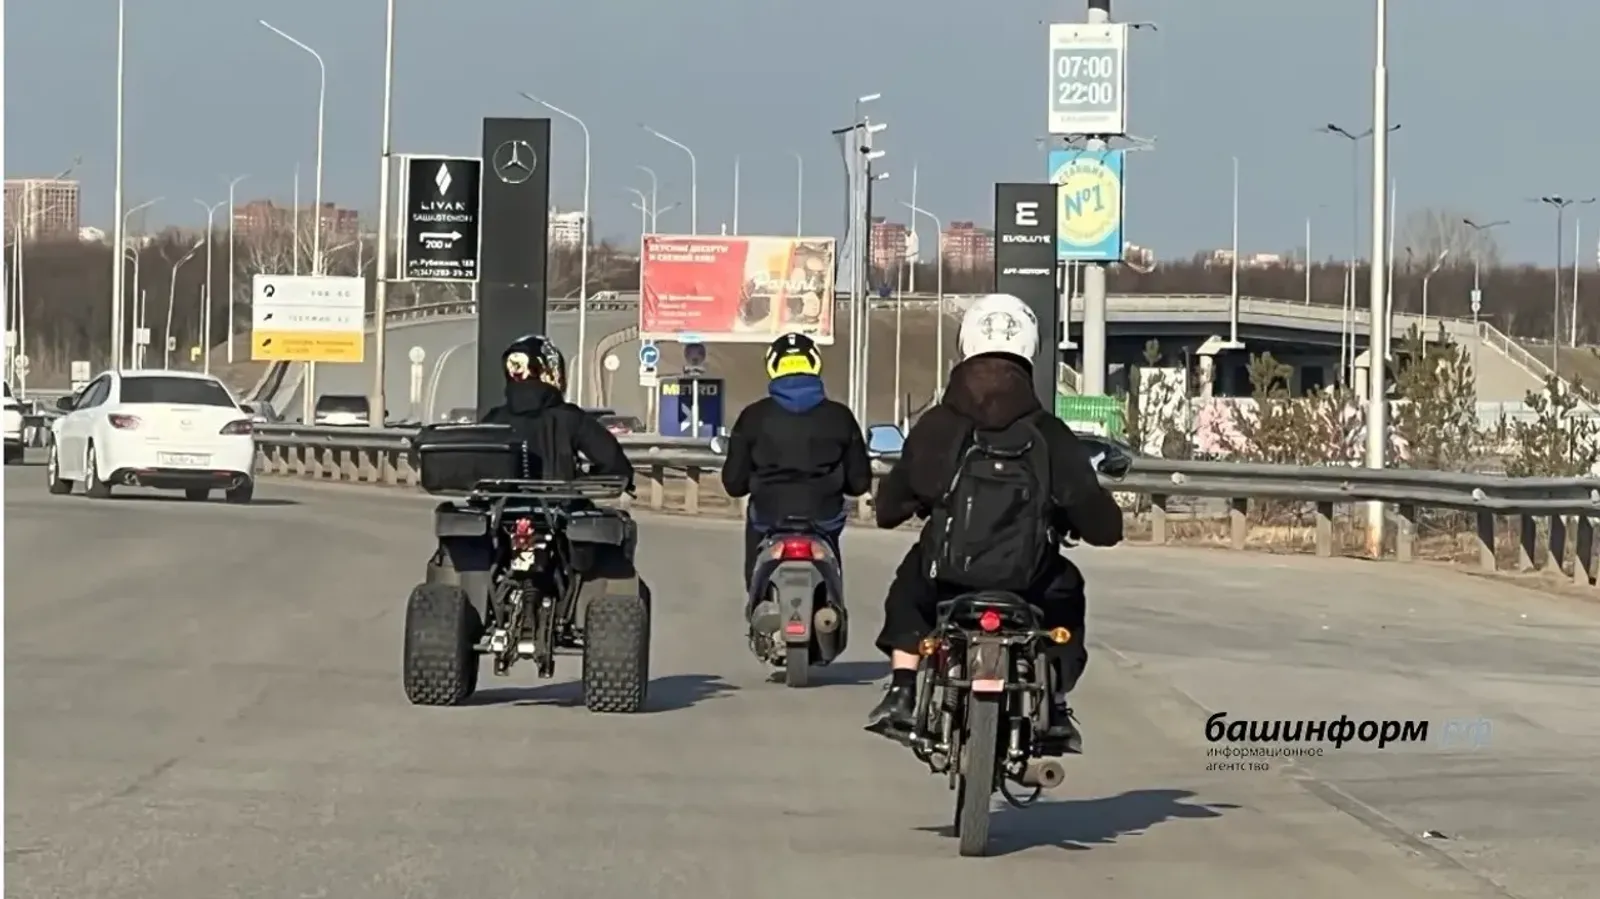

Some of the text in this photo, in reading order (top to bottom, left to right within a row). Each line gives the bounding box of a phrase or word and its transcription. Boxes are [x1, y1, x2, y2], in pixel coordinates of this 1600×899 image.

[1058, 56, 1113, 78] 07:00
[1058, 82, 1113, 104] 22:00
[421, 201, 466, 211] LIVAN
[425, 239, 443, 249] 200
[1002, 234, 1051, 243] EVOLUTE
[663, 384, 718, 396] METRO
